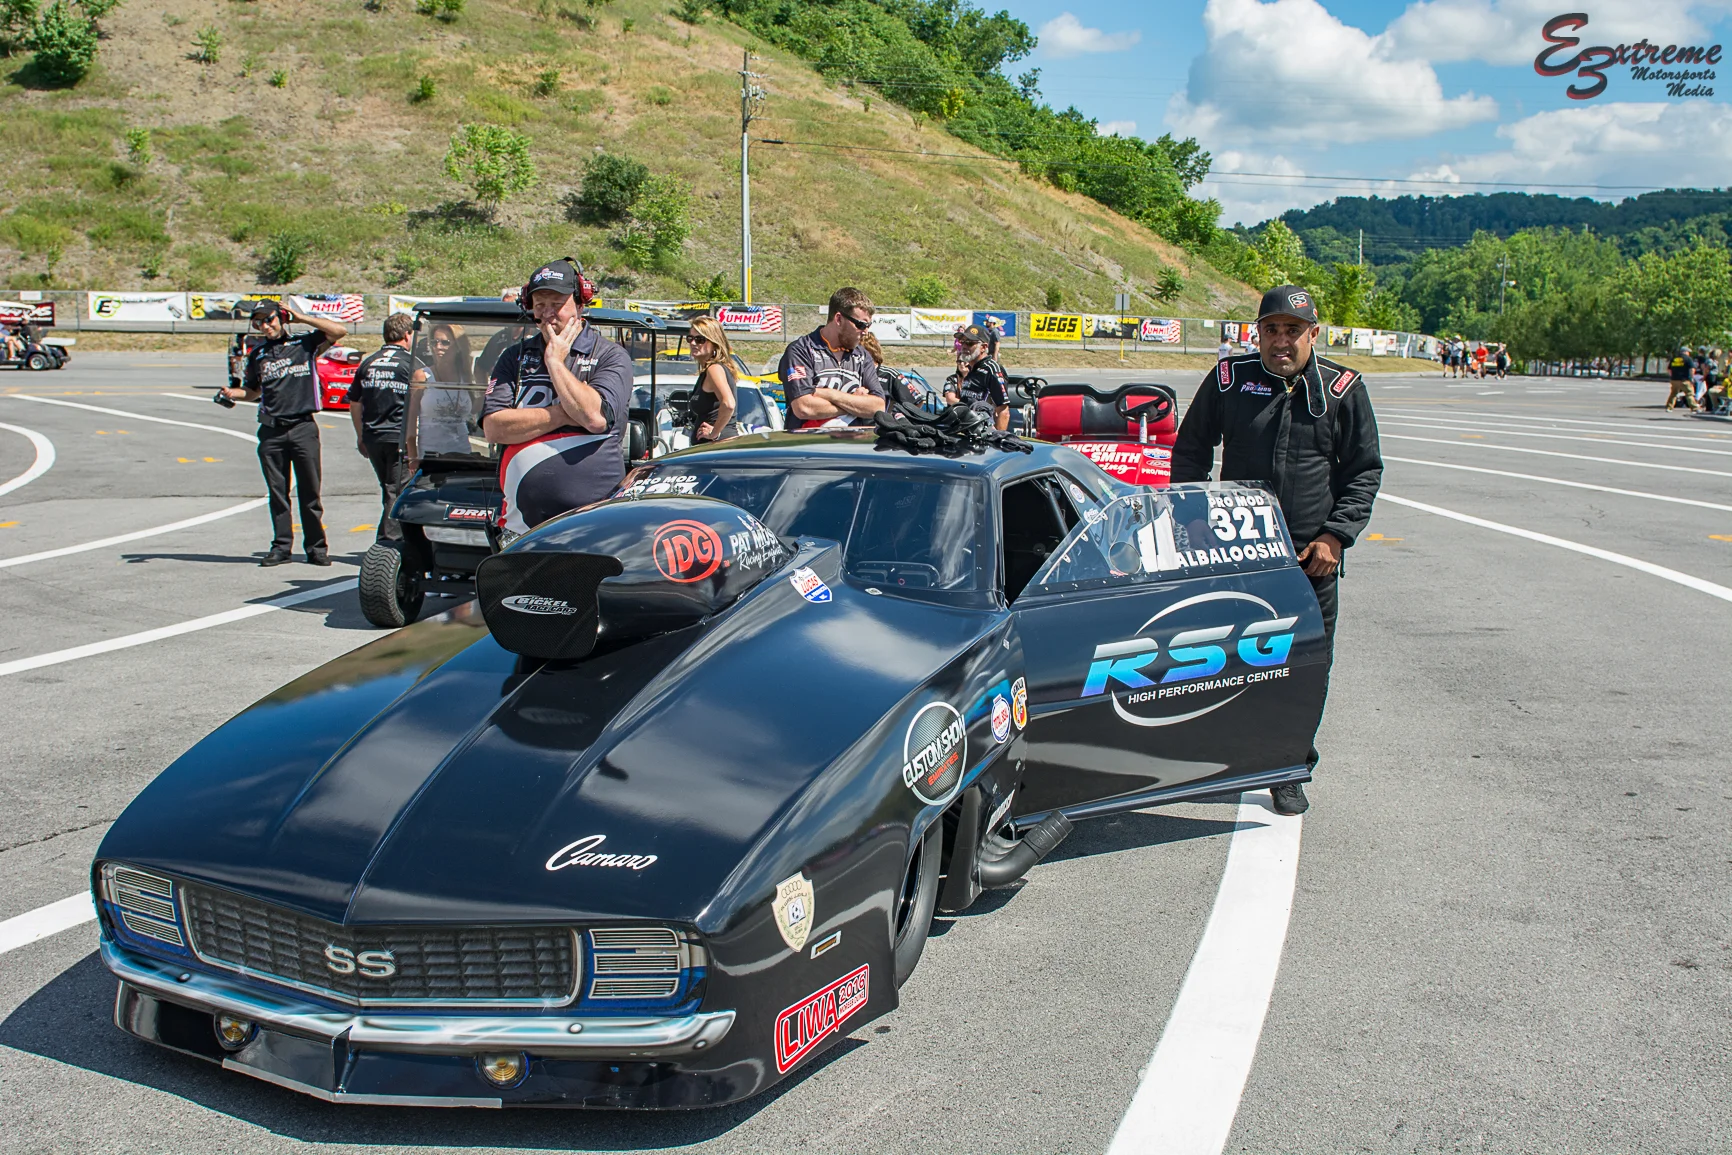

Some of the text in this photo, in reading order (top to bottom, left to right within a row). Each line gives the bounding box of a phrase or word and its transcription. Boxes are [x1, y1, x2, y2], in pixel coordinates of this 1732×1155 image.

[311, 301, 342, 312] MMIT
[1036, 316, 1078, 332] JEGS
[260, 360, 310, 382] nderground
[263, 357, 292, 373] Agave
[367, 368, 395, 380] Agave
[361, 378, 408, 390] Undergroun
[1090, 452, 1141, 464] SMITH
[633, 475, 697, 487] PRO MOD
[1208, 495, 1265, 509] PRO MOD
[1210, 505, 1277, 541] 327
[729, 531, 751, 556] PAT
[661, 534, 713, 576] IDG
[737, 551, 762, 571] Racing
[1175, 541, 1289, 568] ALBALOOSHI
[801, 575, 819, 594] LUCAS
[516, 597, 568, 607] BICKEL
[524, 604, 550, 612] RACE
[1081, 616, 1299, 698] RSG
[1127, 668, 1291, 704] HIGH PERFORMANCE CENTRE
[903, 714, 967, 788] CUSTOM SHOW
[928, 752, 959, 786] EMIRATES
[545, 834, 658, 871] Camaro
[324, 944, 397, 979] SS
[783, 973, 866, 1058] LIWA 2016
